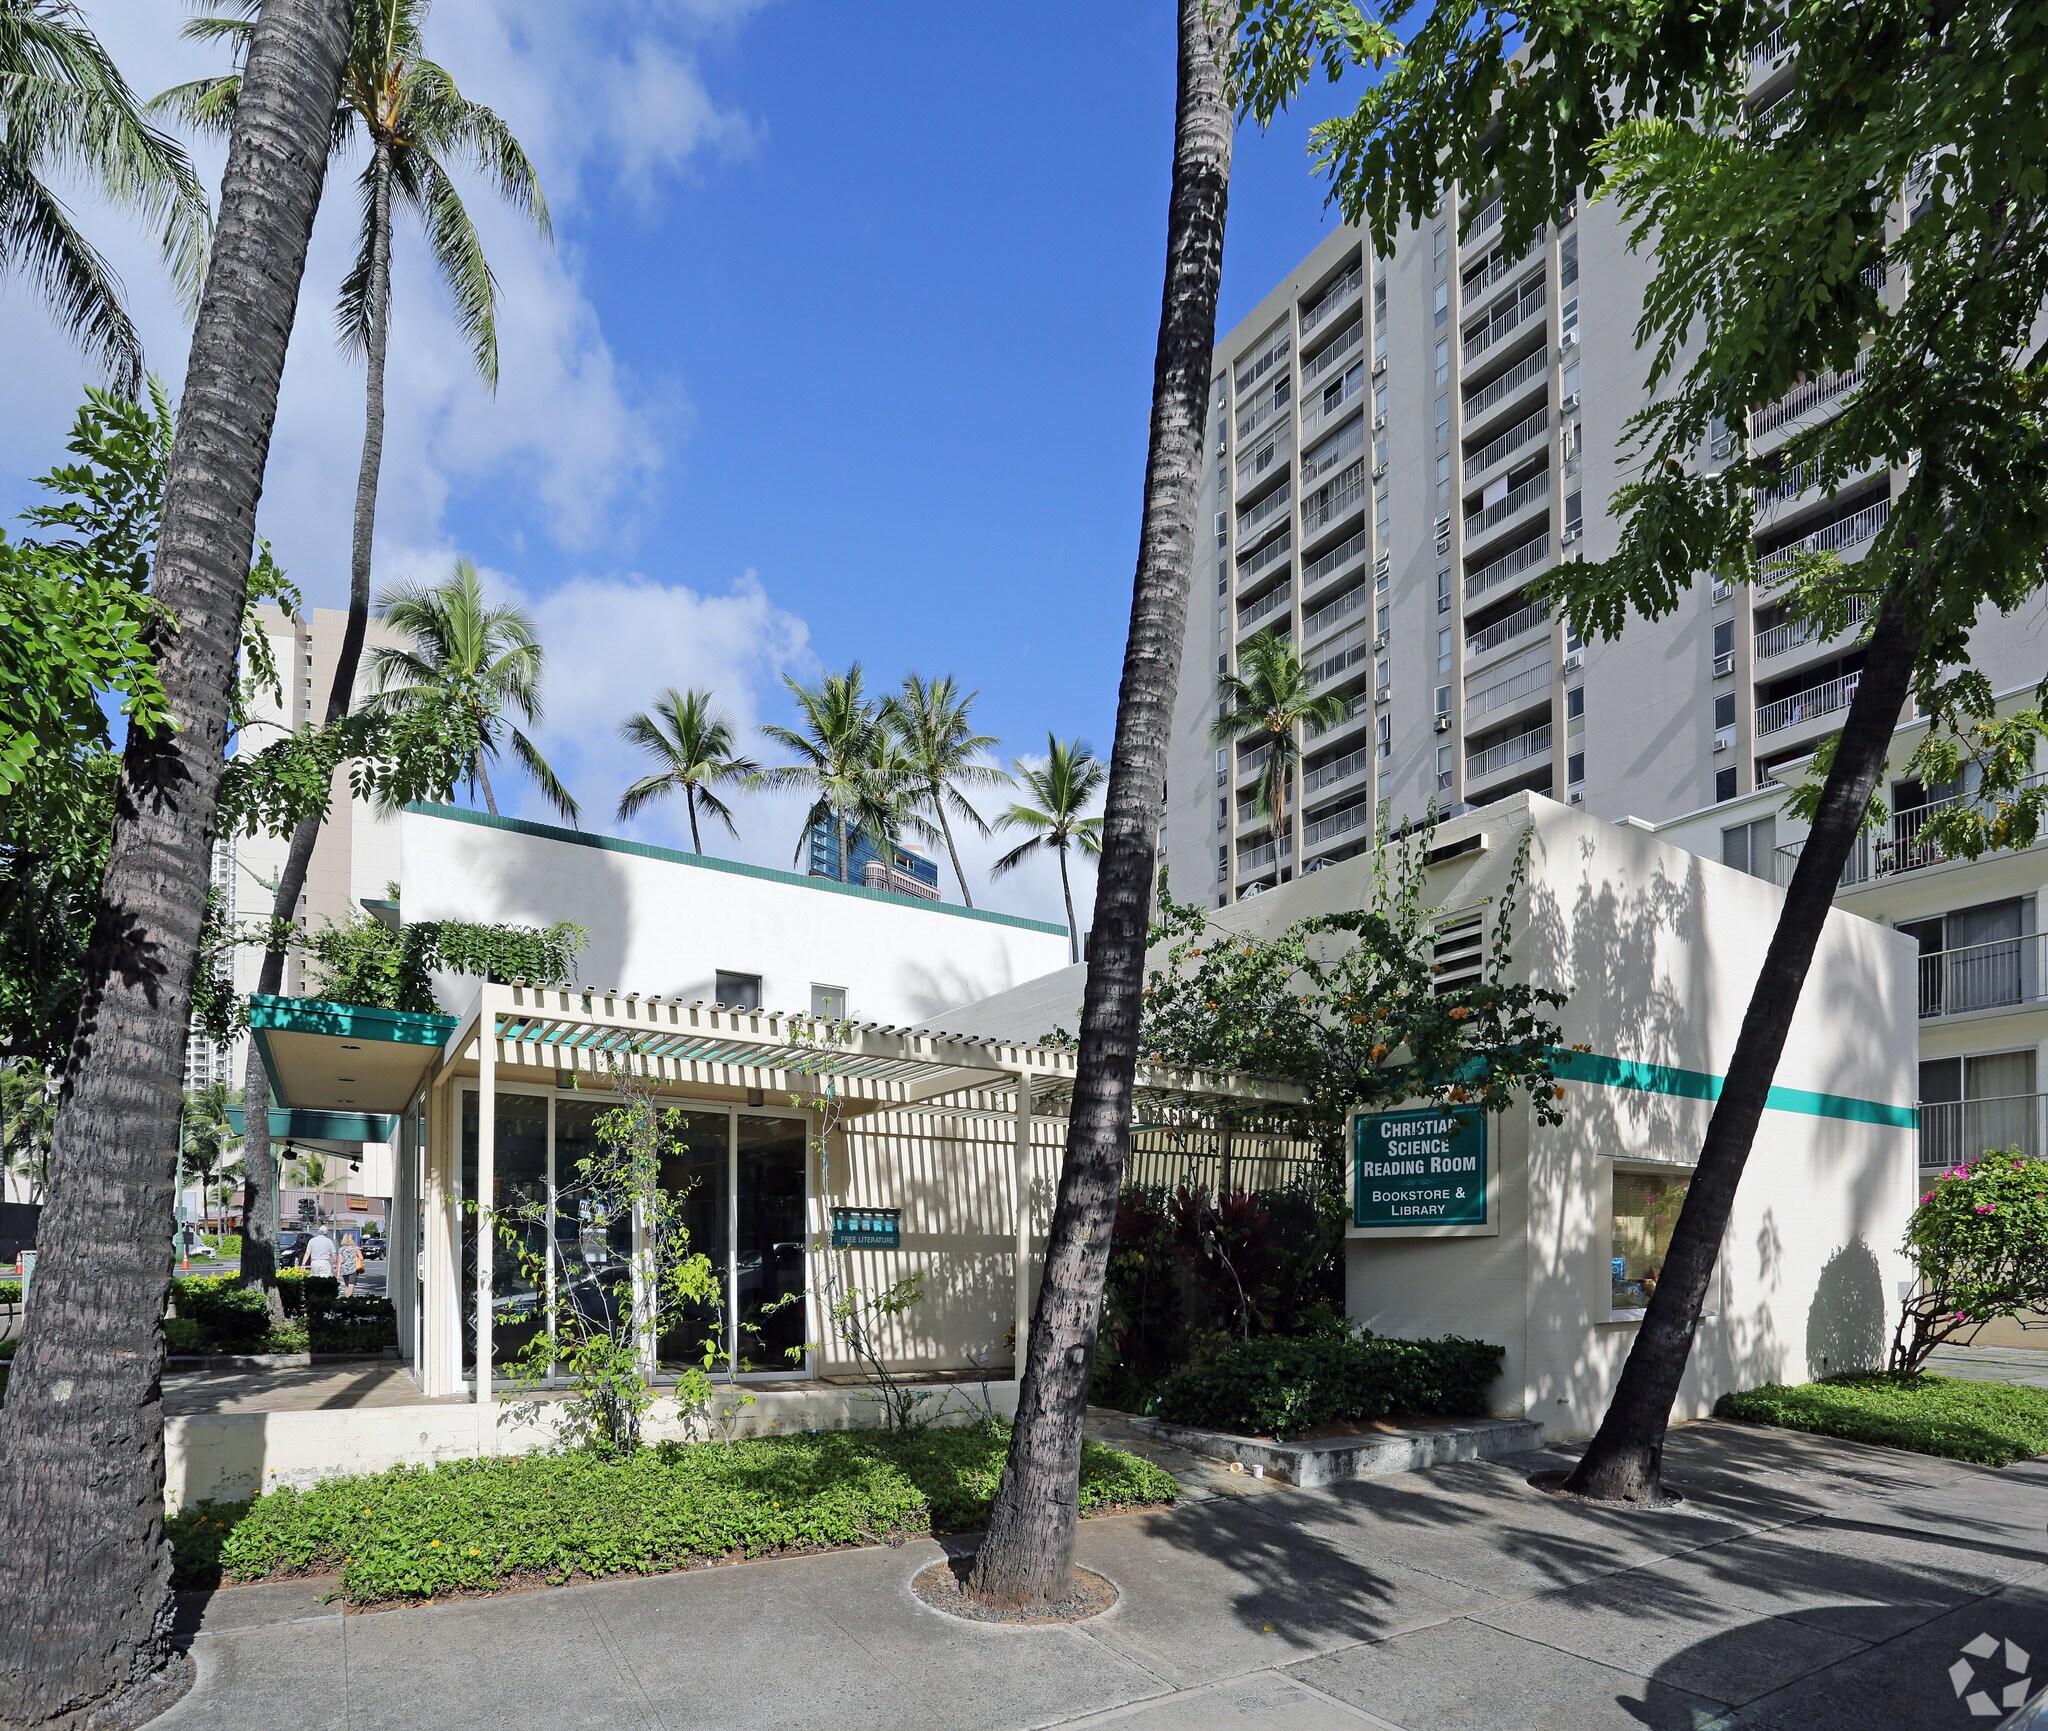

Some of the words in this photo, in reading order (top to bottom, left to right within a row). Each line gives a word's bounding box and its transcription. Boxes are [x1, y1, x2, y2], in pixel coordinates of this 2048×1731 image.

[1388, 1139, 1449, 1156] SCIENCE
[1364, 1160, 1424, 1177] READING
[1430, 1156, 1476, 1173] ROOM
[1372, 1190, 1450, 1202] BOOKSTORE
[1455, 1186, 1466, 1199] &
[1391, 1204, 1445, 1216] LIBRARY
